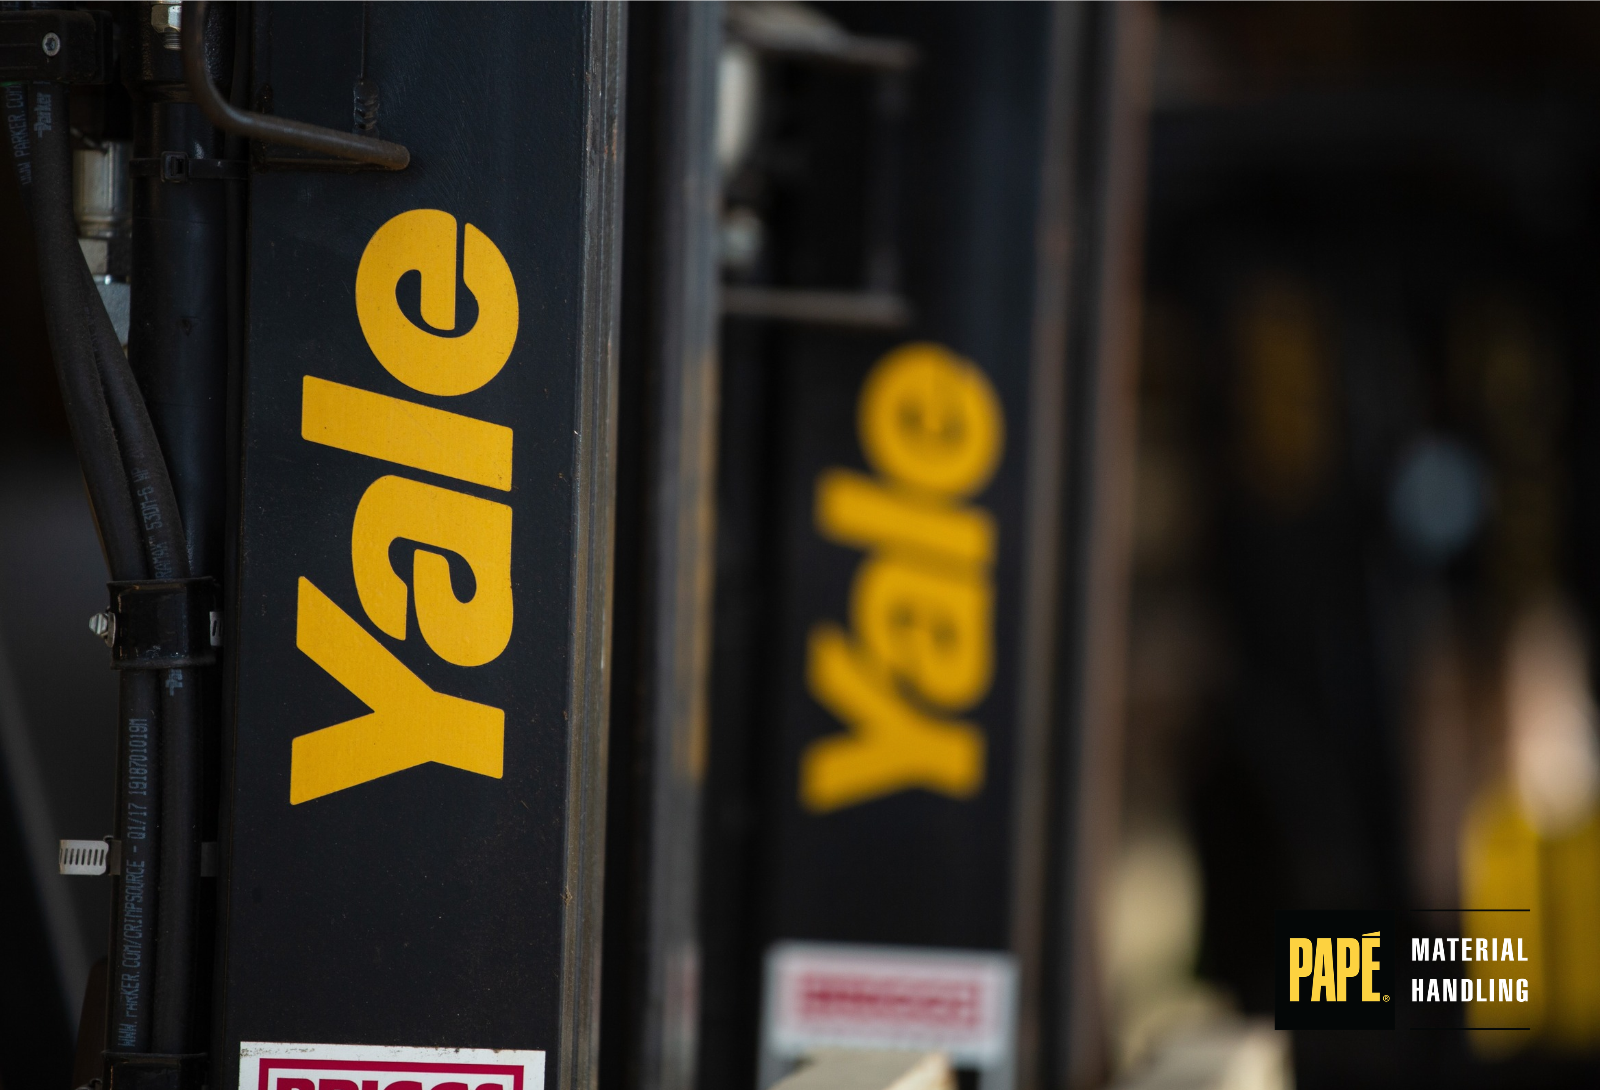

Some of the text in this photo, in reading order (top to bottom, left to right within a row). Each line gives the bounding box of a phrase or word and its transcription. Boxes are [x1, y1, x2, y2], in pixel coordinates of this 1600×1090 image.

[33, 92, 53, 139] Parker
[137, 486, 164, 530] 53DM-6
[290, 208, 520, 806] Yale
[802, 343, 1005, 813] Yale
[128, 718, 148, 796] 1918701019M
